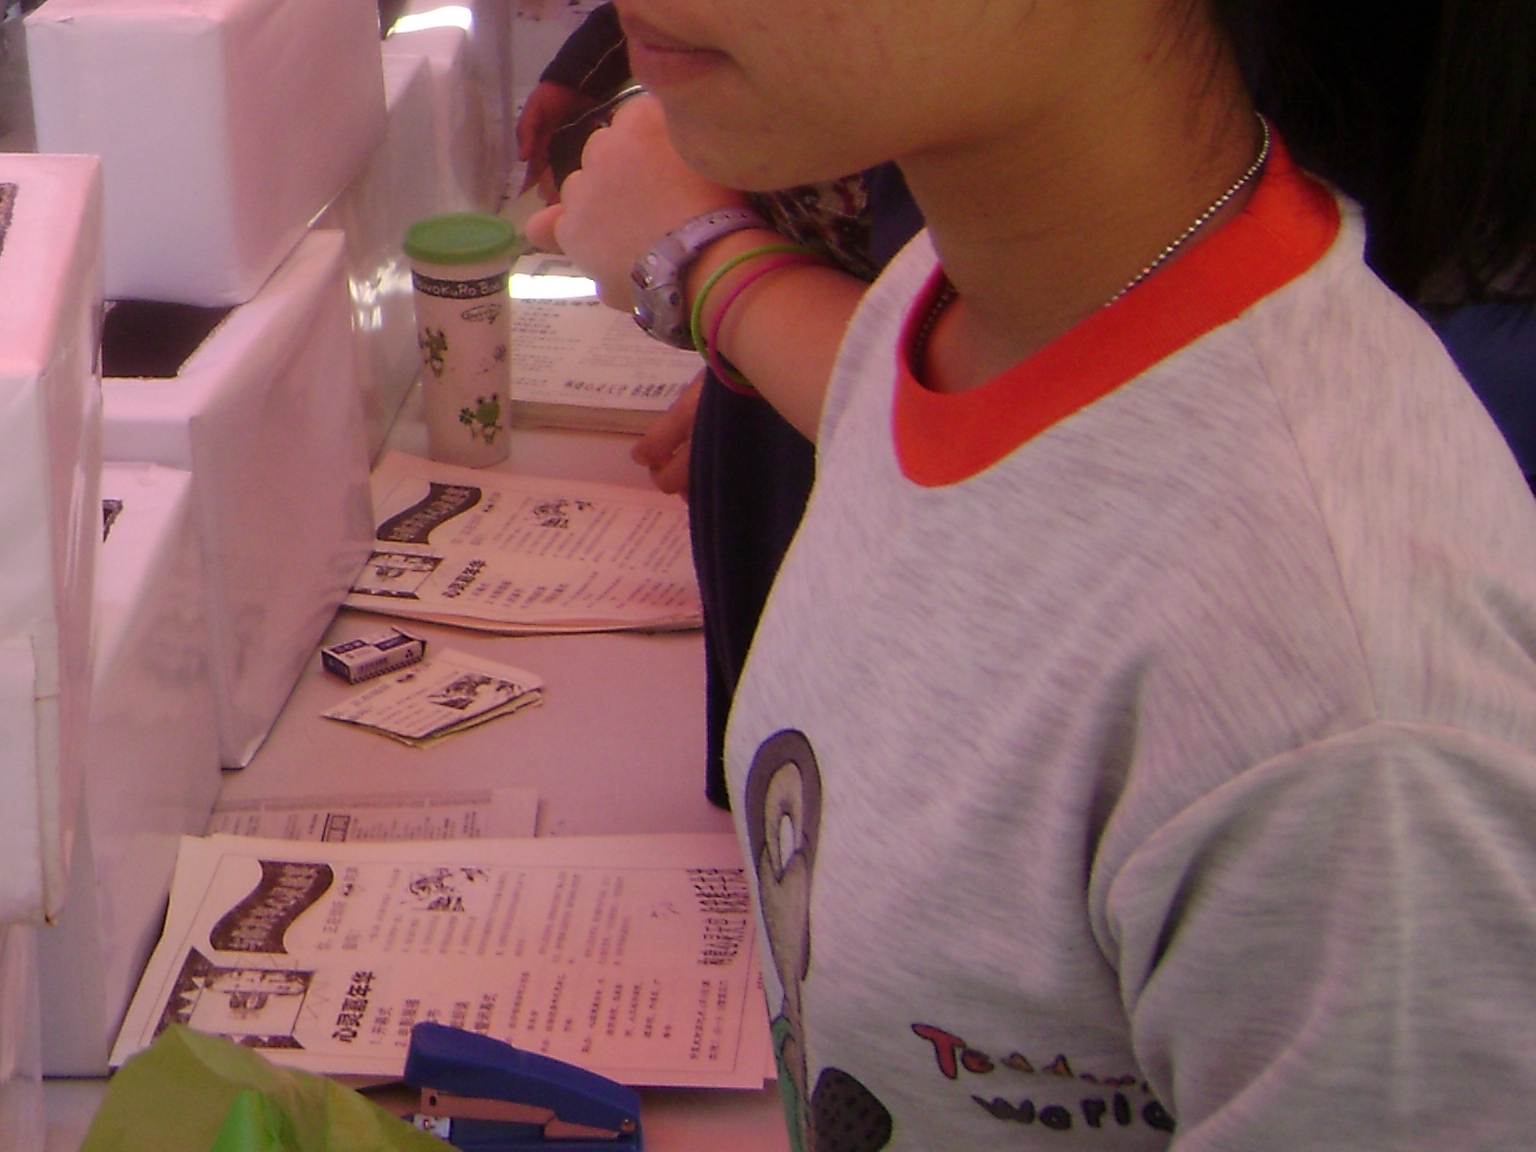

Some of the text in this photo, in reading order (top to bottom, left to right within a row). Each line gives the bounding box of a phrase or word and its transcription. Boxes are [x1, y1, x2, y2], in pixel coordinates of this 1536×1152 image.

[330, 969, 377, 1044] 心灵嘉年华
